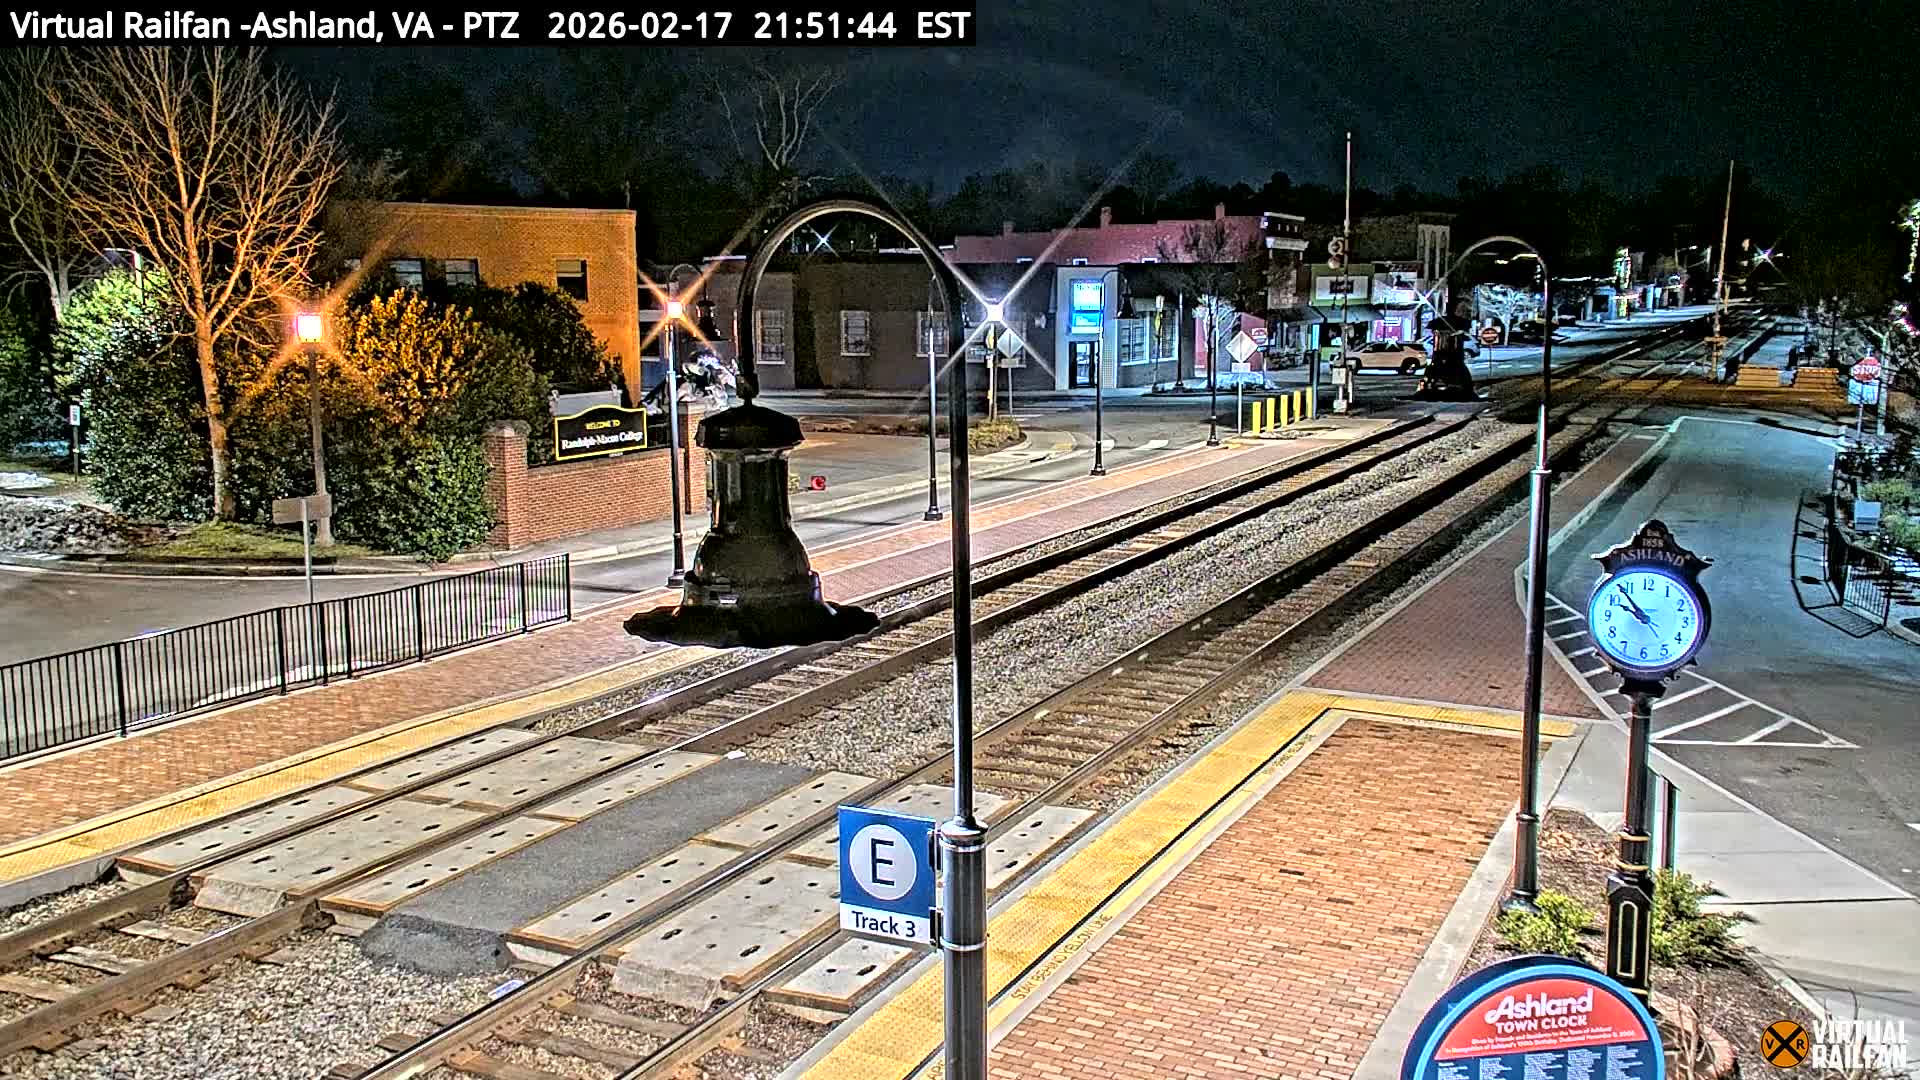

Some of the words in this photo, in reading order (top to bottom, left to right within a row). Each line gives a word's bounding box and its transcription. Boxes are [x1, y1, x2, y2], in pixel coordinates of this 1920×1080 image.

[1853, 365, 1881, 378] STOP
[1621, 549, 1684, 566] ASHLAND
[1643, 578, 1655, 591] 12
[1665, 586, 1670, 597] 1
[1609, 594, 1620, 606] 10
[1677, 599, 1684, 611] 2
[1605, 610, 1611, 621] 9
[1682, 617, 1689, 628] 3
[1608, 626, 1616, 638] 8
[1675, 632, 1682, 644] 4
[1620, 641, 1627, 652] 7
[1640, 647, 1648, 659] 6
[1660, 644, 1668, 656] 5
[871, 838, 894, 886] E
[852, 911, 899, 936] Track
[906, 920, 916, 937] 3
[1484, 988, 1593, 1024] Ashland
[1496, 1020, 1538, 1034] TOWN
[1541, 1014, 1587, 1029] CLOCK
